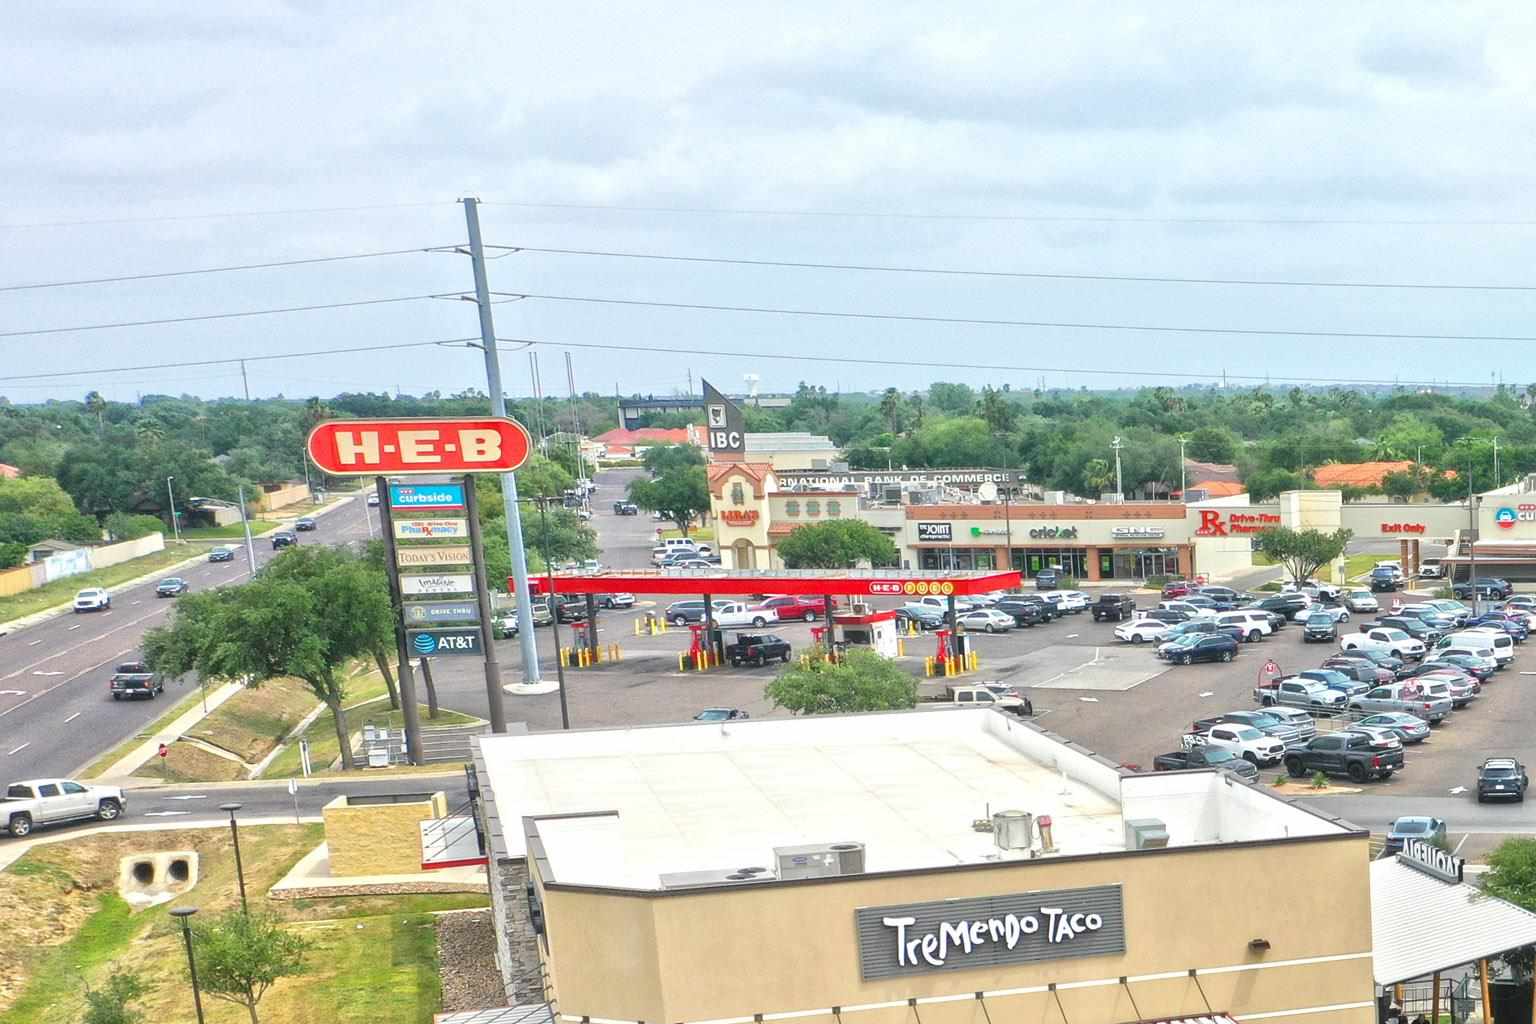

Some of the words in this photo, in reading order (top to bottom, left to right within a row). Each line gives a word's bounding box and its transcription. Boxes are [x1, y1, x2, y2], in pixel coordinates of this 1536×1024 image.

[335, 428, 502, 465] H-E-B
[710, 431, 741, 448] IBC
[399, 492, 454, 503] curbside
[1381, 523, 1403, 533] Exit
[1404, 523, 1426, 534] Only
[438, 635, 475, 650] AT&T
